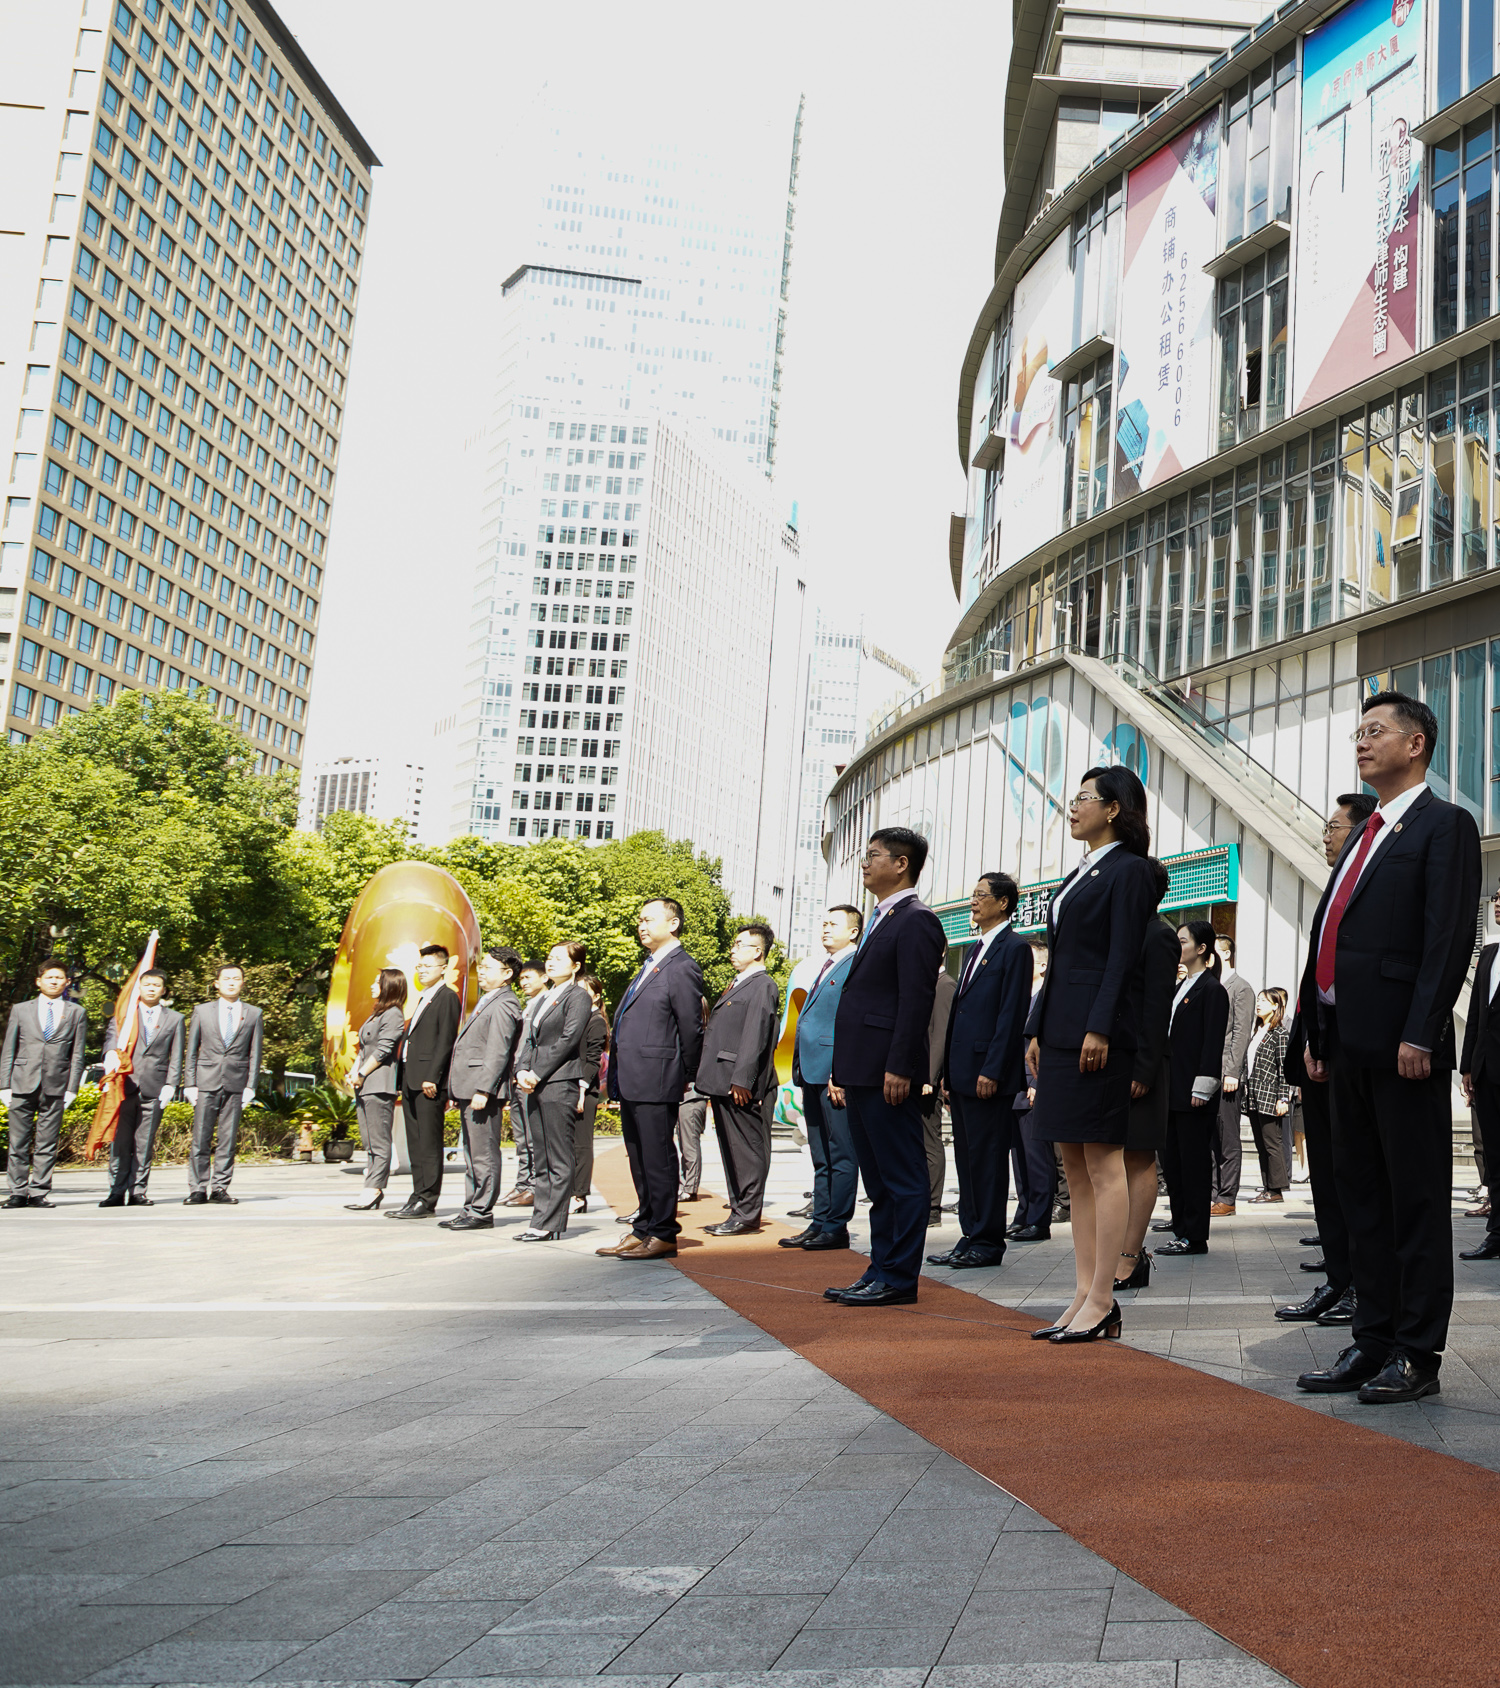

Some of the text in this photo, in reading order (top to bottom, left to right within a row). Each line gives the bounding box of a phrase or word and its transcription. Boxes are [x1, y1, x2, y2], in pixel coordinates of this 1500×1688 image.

[1158, 205, 1177, 391] 商铺办公租赁
